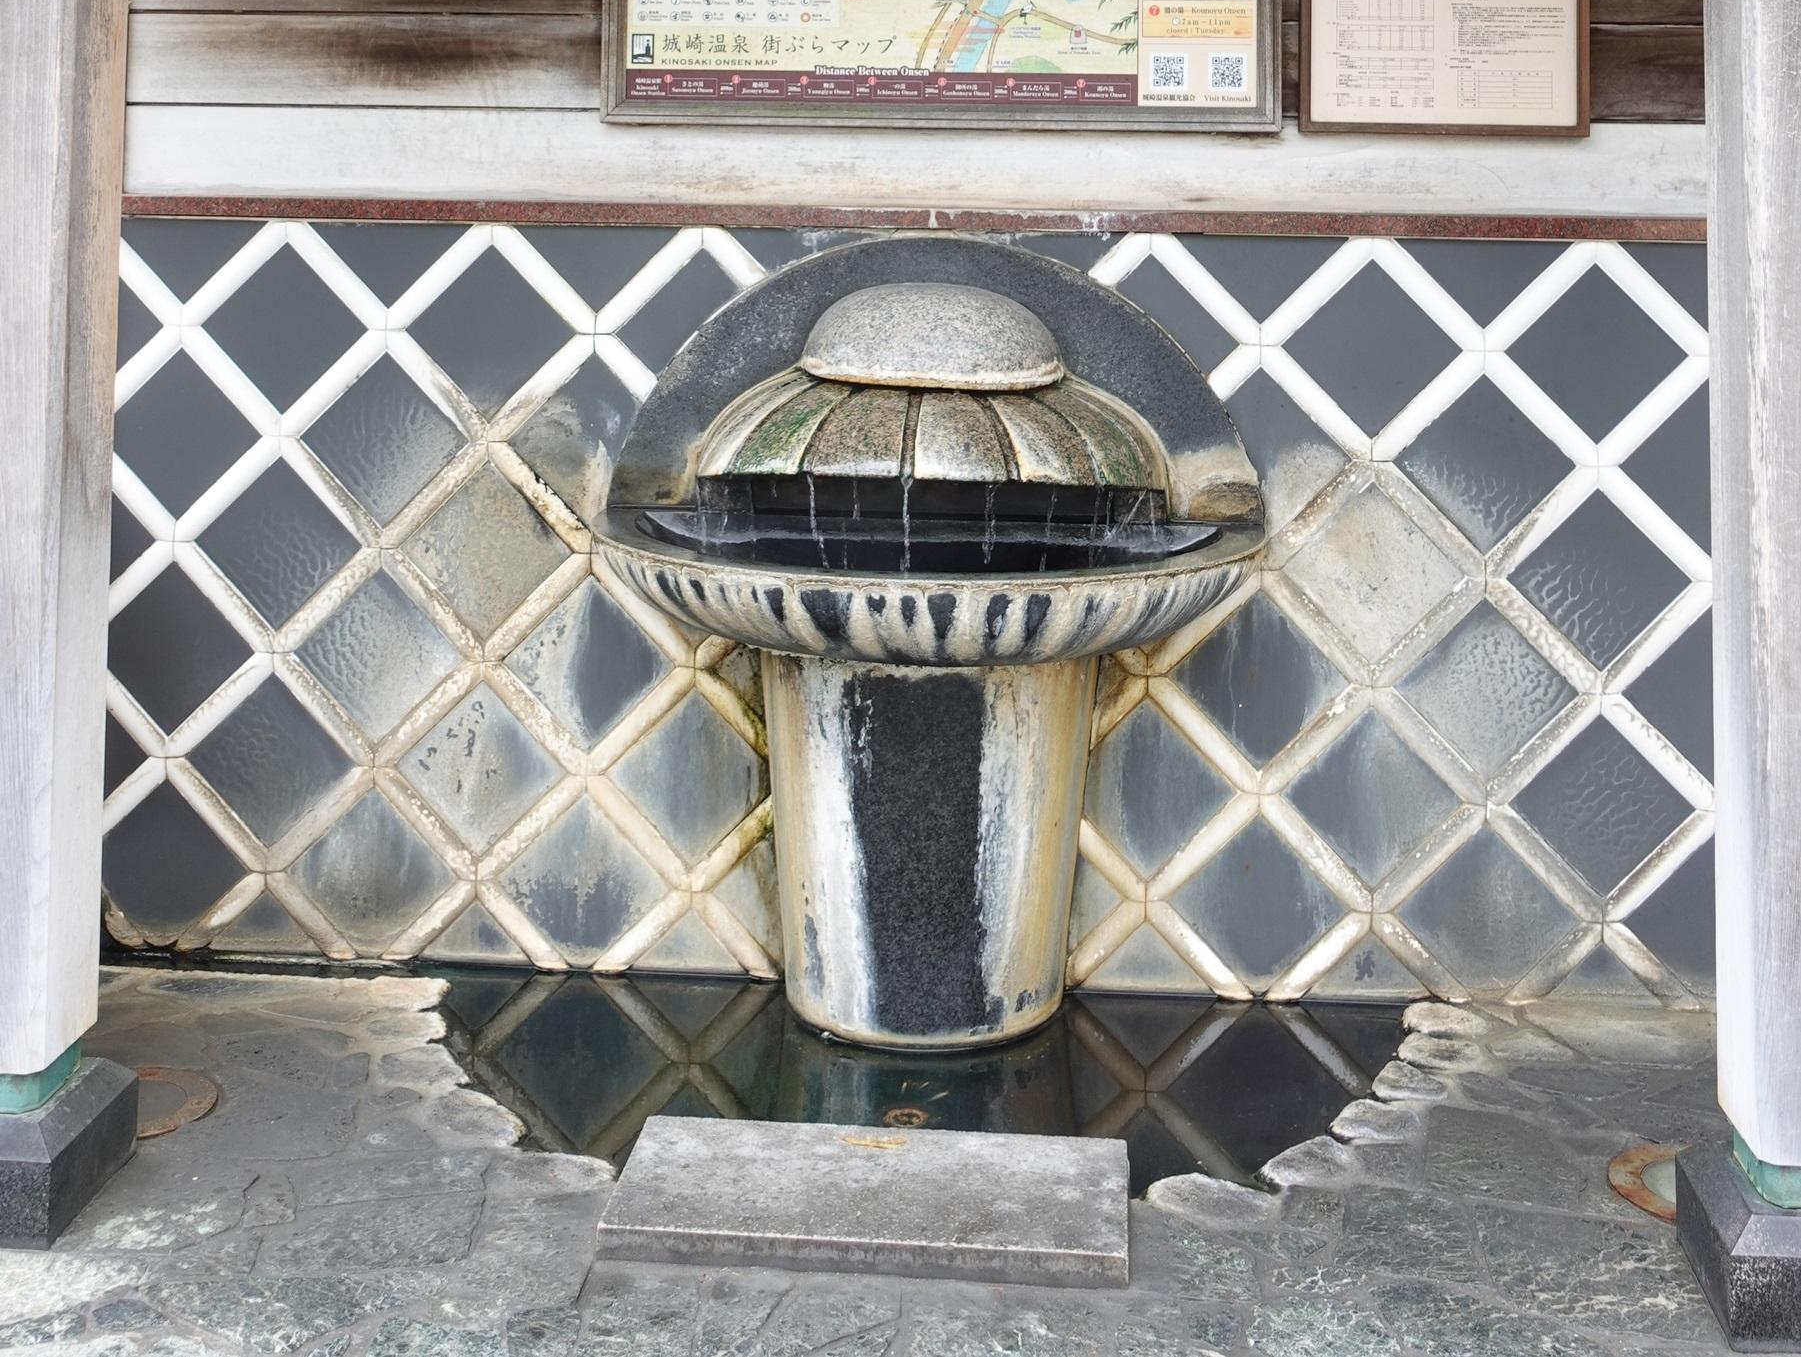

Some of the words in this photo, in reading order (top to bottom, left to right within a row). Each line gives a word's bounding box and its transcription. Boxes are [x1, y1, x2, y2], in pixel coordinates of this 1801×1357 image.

[662, 33, 750, 54] 城崎温泉
[762, 34, 898, 55] 街ぶらマップ
[661, 58, 712, 66] KINOSAKI
[815, 66, 856, 75] Distance
[858, 66, 898, 76] Between
[901, 66, 930, 76] Onsen
